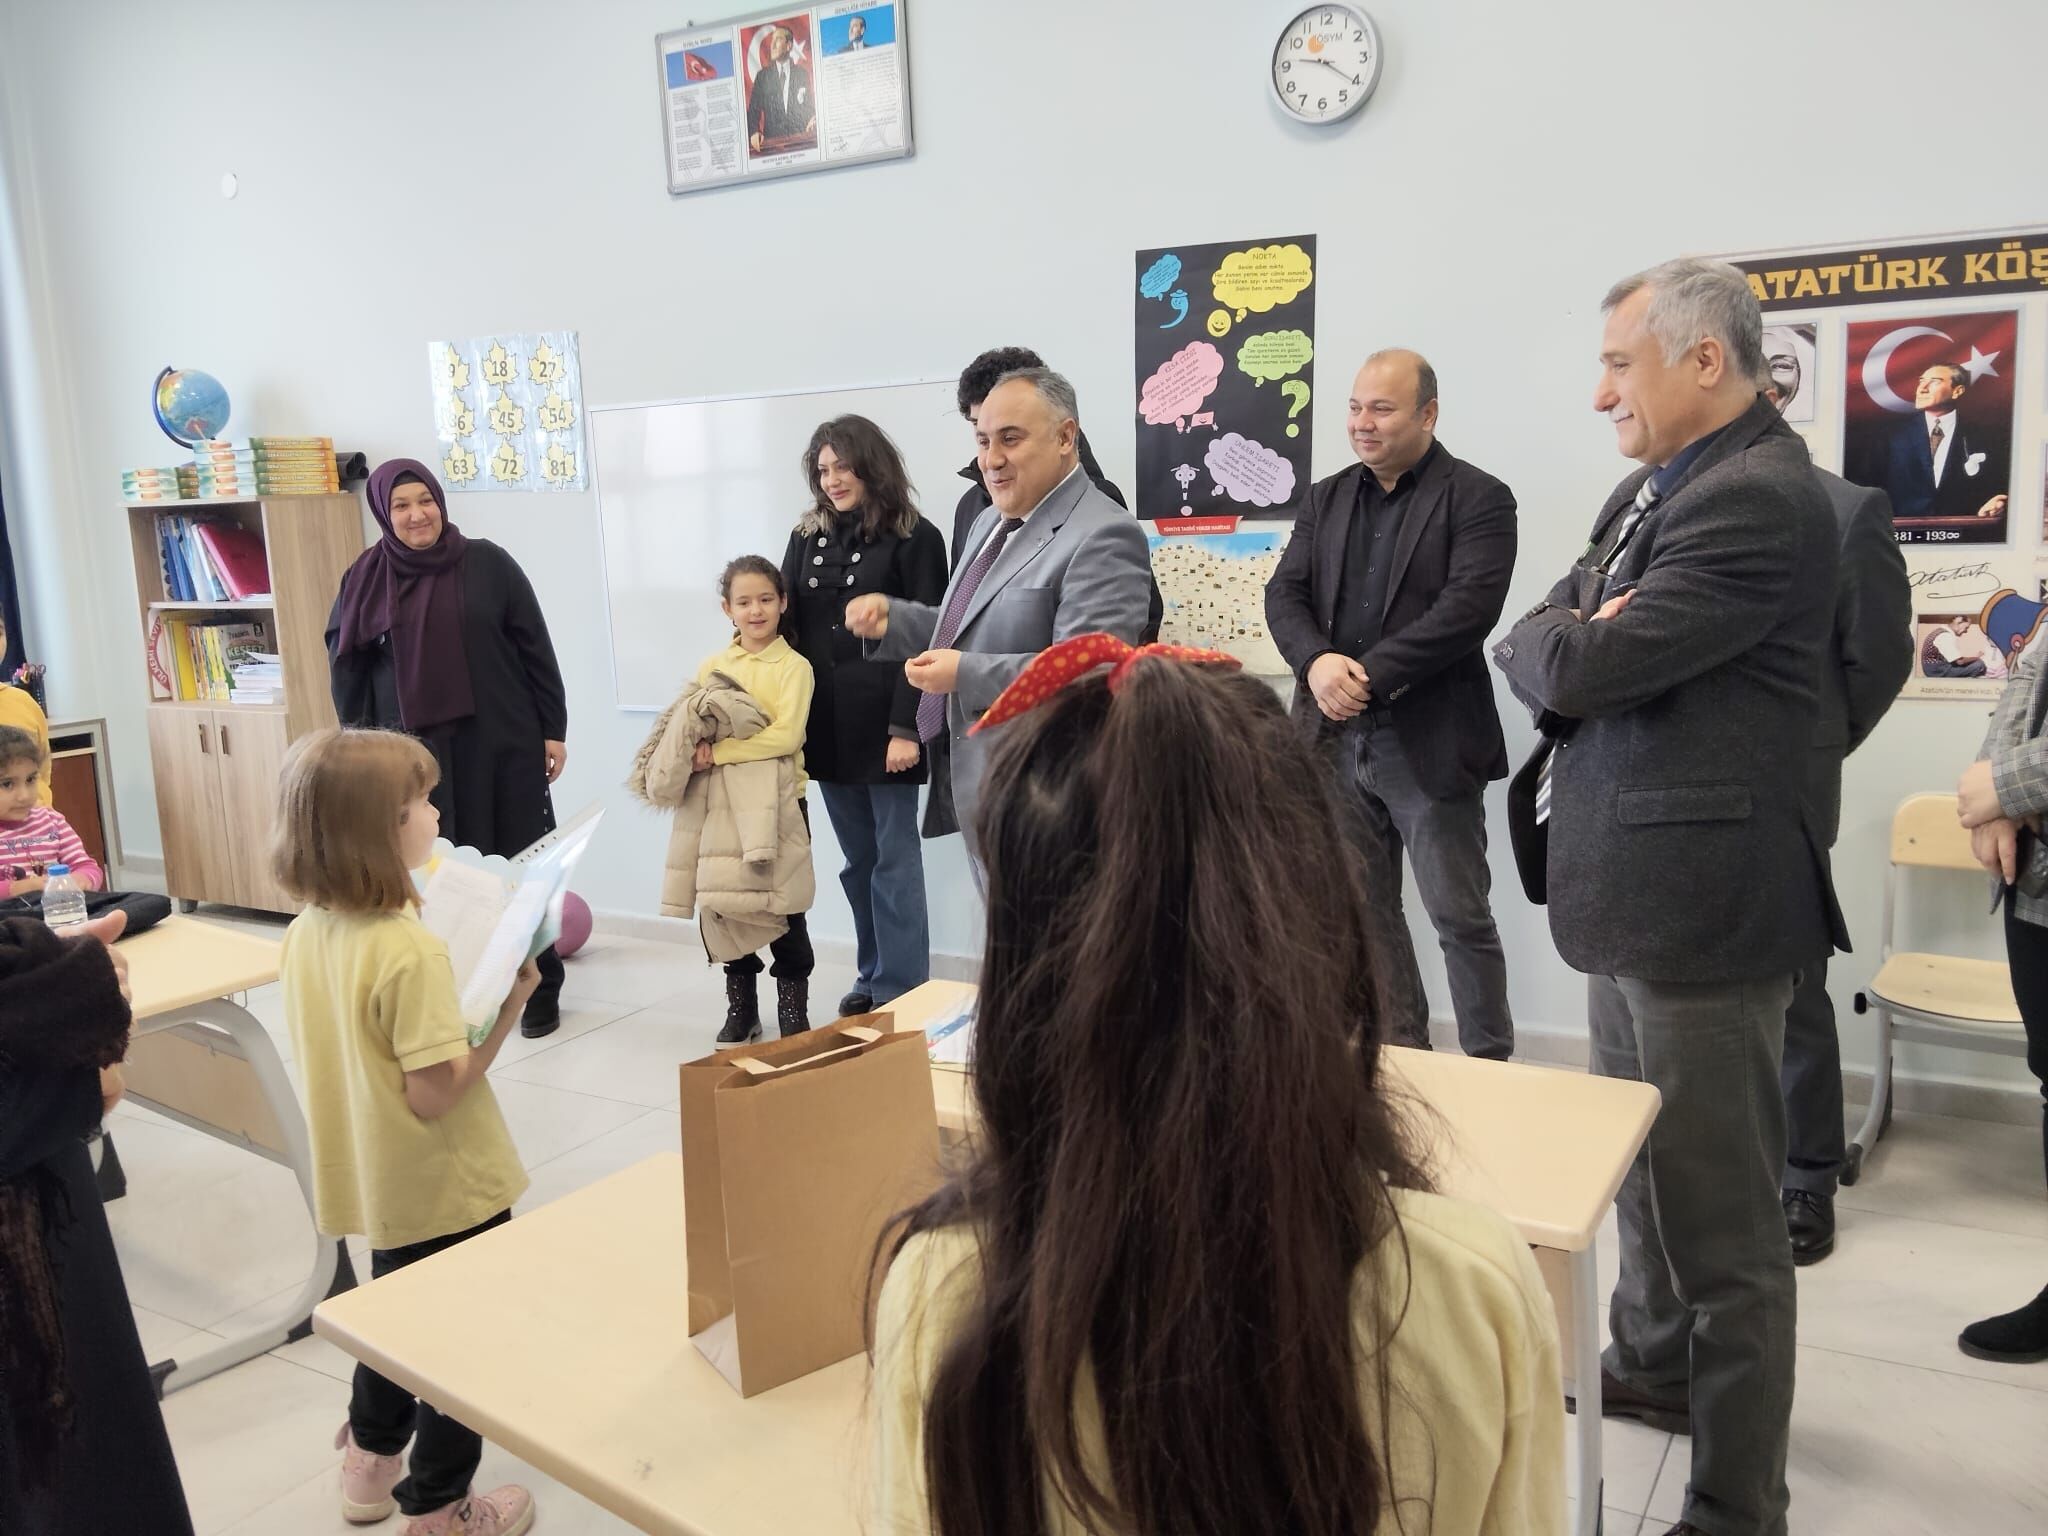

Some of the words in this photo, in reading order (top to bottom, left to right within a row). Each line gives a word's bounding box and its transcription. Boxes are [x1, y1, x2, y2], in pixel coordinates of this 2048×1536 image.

[1320, 12, 1333, 26] 12
[1304, 20, 1311, 34] 11
[1353, 30, 1363, 42] 2
[1290, 37, 1303, 50] 10
[1360, 51, 1368, 64] 3
[1281, 61, 1291, 73] 9
[1286, 81, 1296, 93] 8
[1352, 74, 1361, 86] 4
[1298, 94, 1308, 107] 7
[1339, 89, 1348, 102] 5
[1317, 97, 1327, 110] 6
[1747, 255, 1949, 301] ATATÜRK
[492, 361, 508, 377] 18
[539, 361, 556, 378] 27
[499, 412, 515, 428] 45
[549, 408, 567, 424] 54
[453, 459, 468, 475] 63
[502, 459, 518, 475] 72
[551, 460, 568, 476] 81
